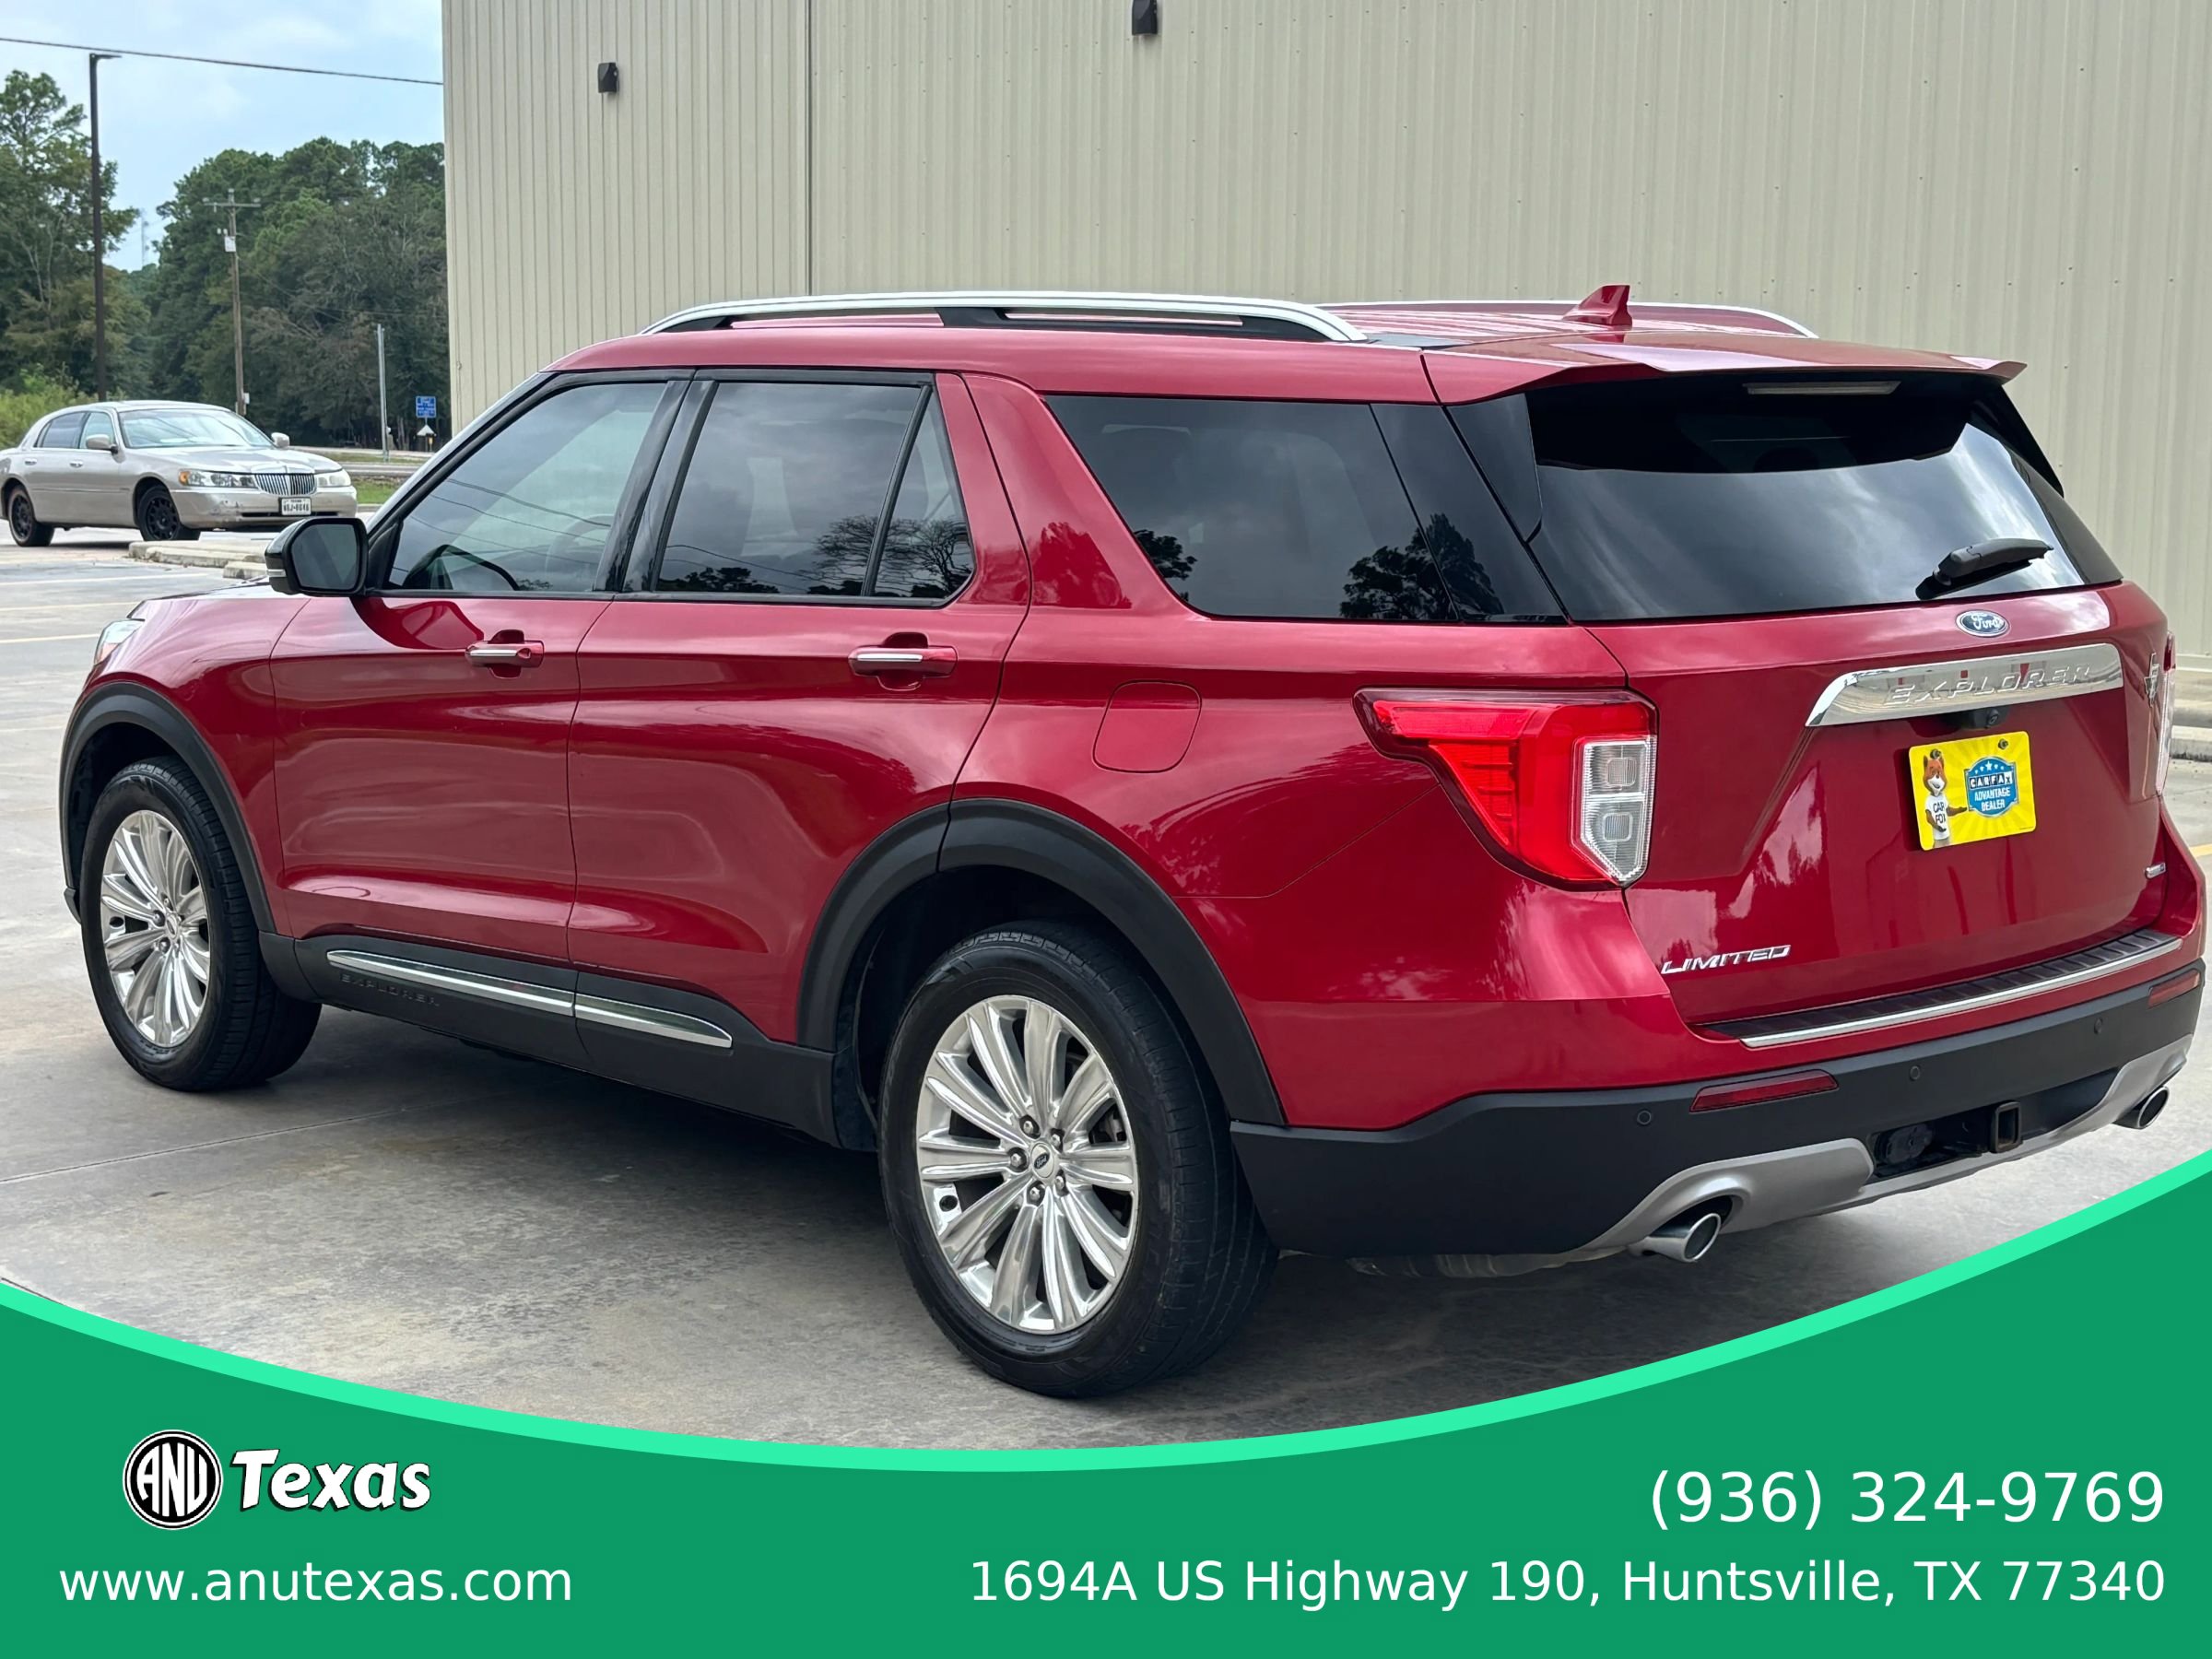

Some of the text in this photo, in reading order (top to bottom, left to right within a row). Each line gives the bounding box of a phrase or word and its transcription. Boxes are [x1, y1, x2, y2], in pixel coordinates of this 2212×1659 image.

[1887, 663, 2090, 706] EXPLORER
[1969, 771, 2013, 789] CARFAX
[1974, 787, 2011, 802] ADVANTAGE
[1933, 801, 1946, 813] CAR
[1981, 799, 2006, 812] DEALER
[1935, 813, 1947, 826] FOX
[1660, 944, 1792, 975] LIMITED
